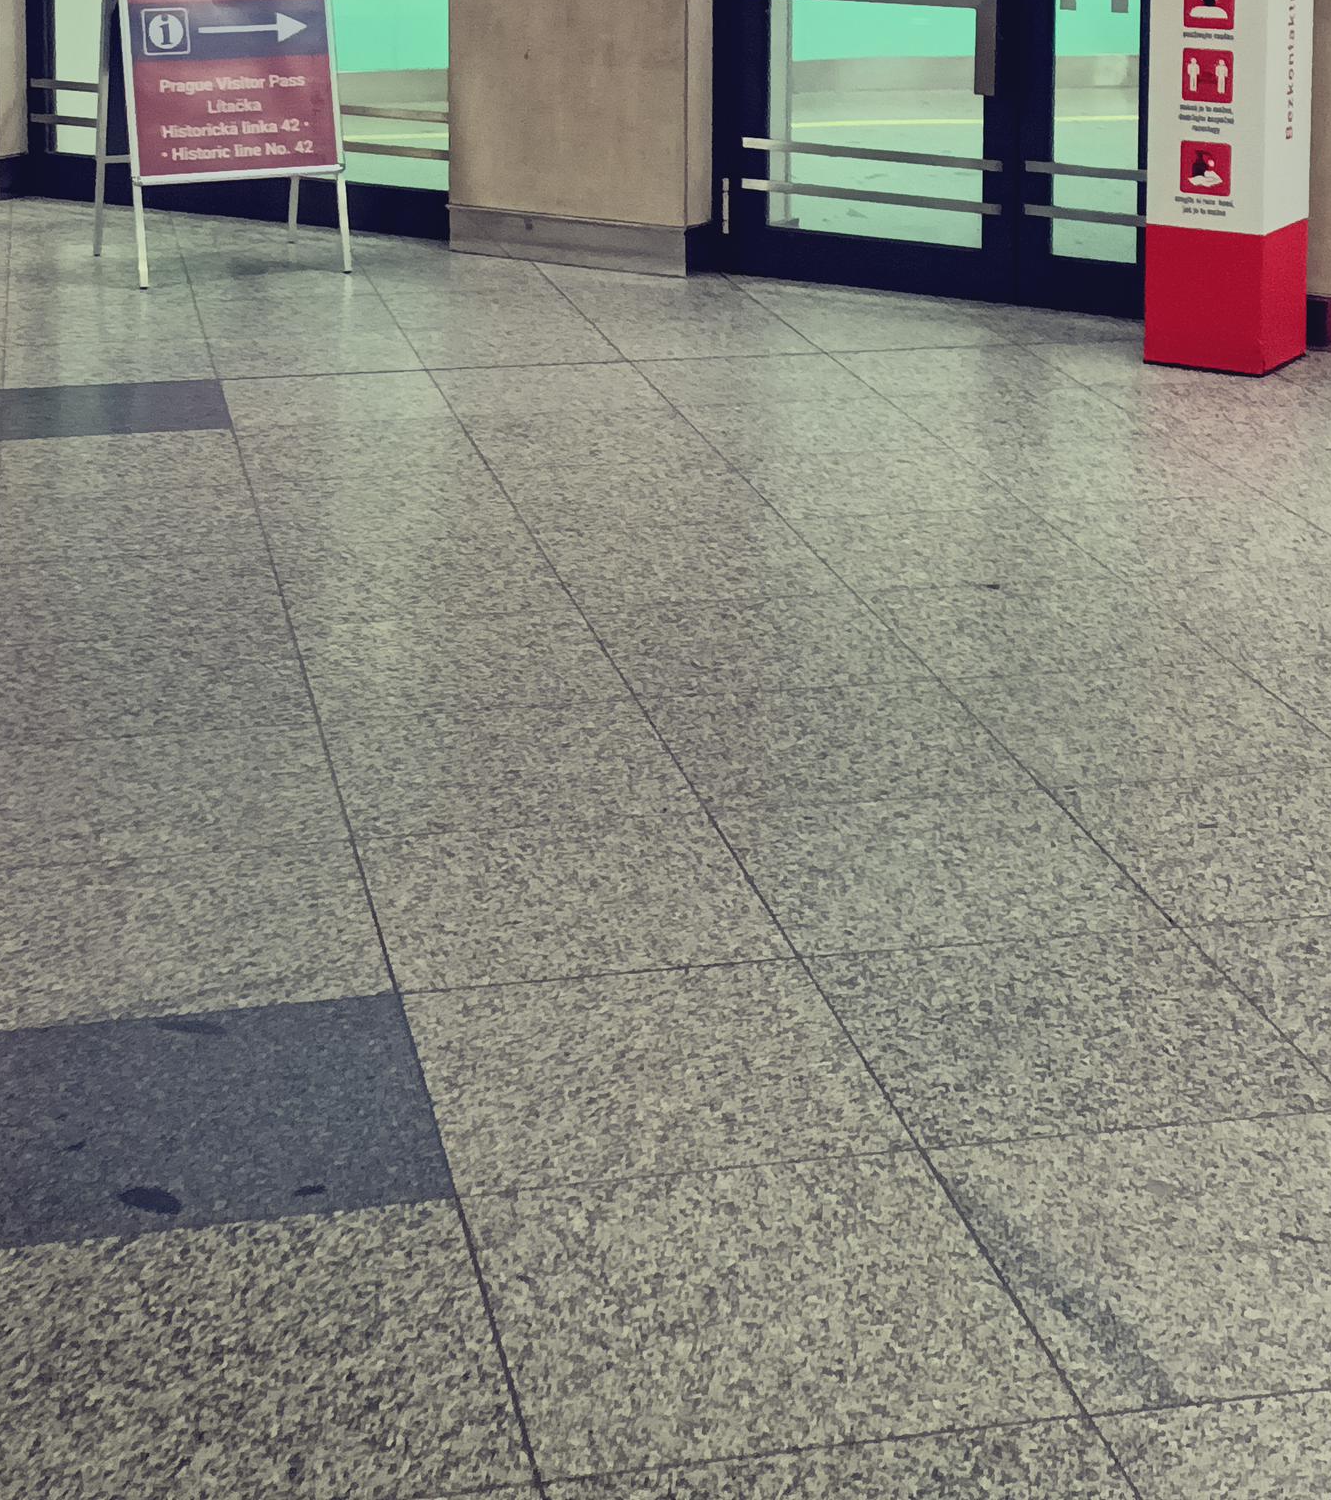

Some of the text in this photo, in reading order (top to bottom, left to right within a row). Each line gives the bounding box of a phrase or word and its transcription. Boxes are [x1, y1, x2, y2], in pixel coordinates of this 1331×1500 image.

[159, 74, 307, 96] Prague Visitor Pass
[162, 118, 300, 139] Historická linka 42
[172, 140, 314, 161] Historic line No. 42
